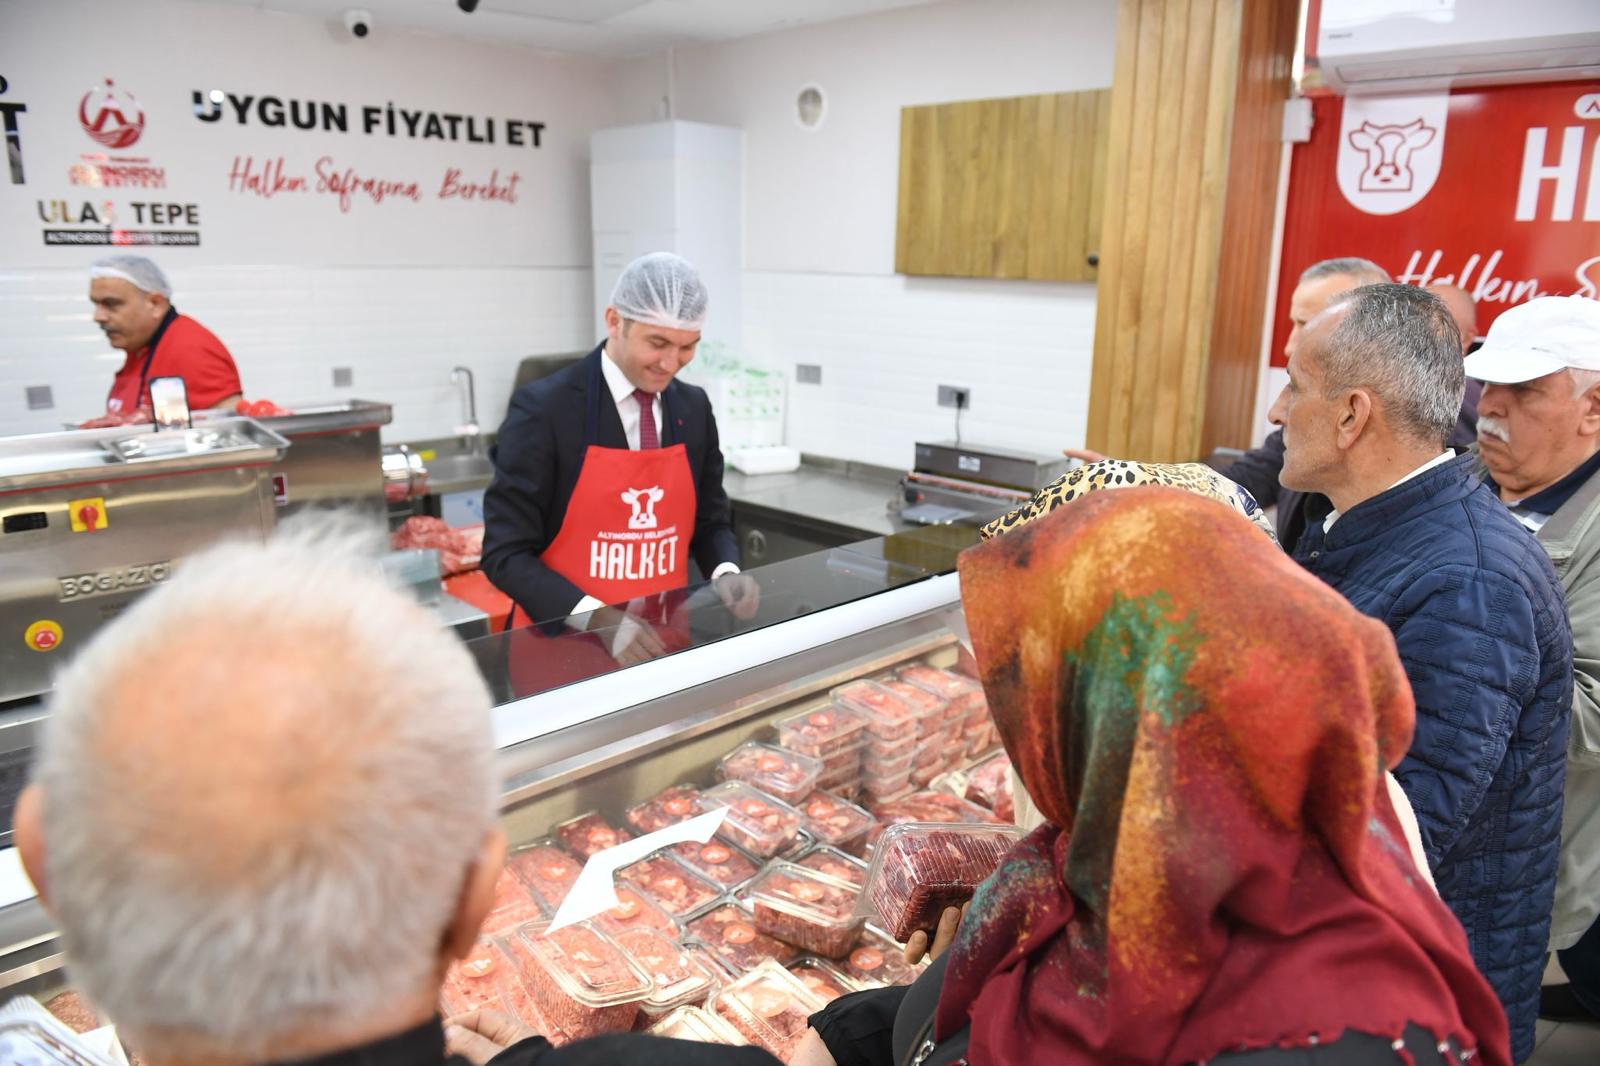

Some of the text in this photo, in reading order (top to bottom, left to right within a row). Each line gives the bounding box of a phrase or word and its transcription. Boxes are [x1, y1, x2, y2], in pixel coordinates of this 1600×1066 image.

[192, 90, 546, 147] UYGUN FİYATLI ET
[131, 202, 200, 225] TEPE
[590, 536, 679, 580] HALKET
